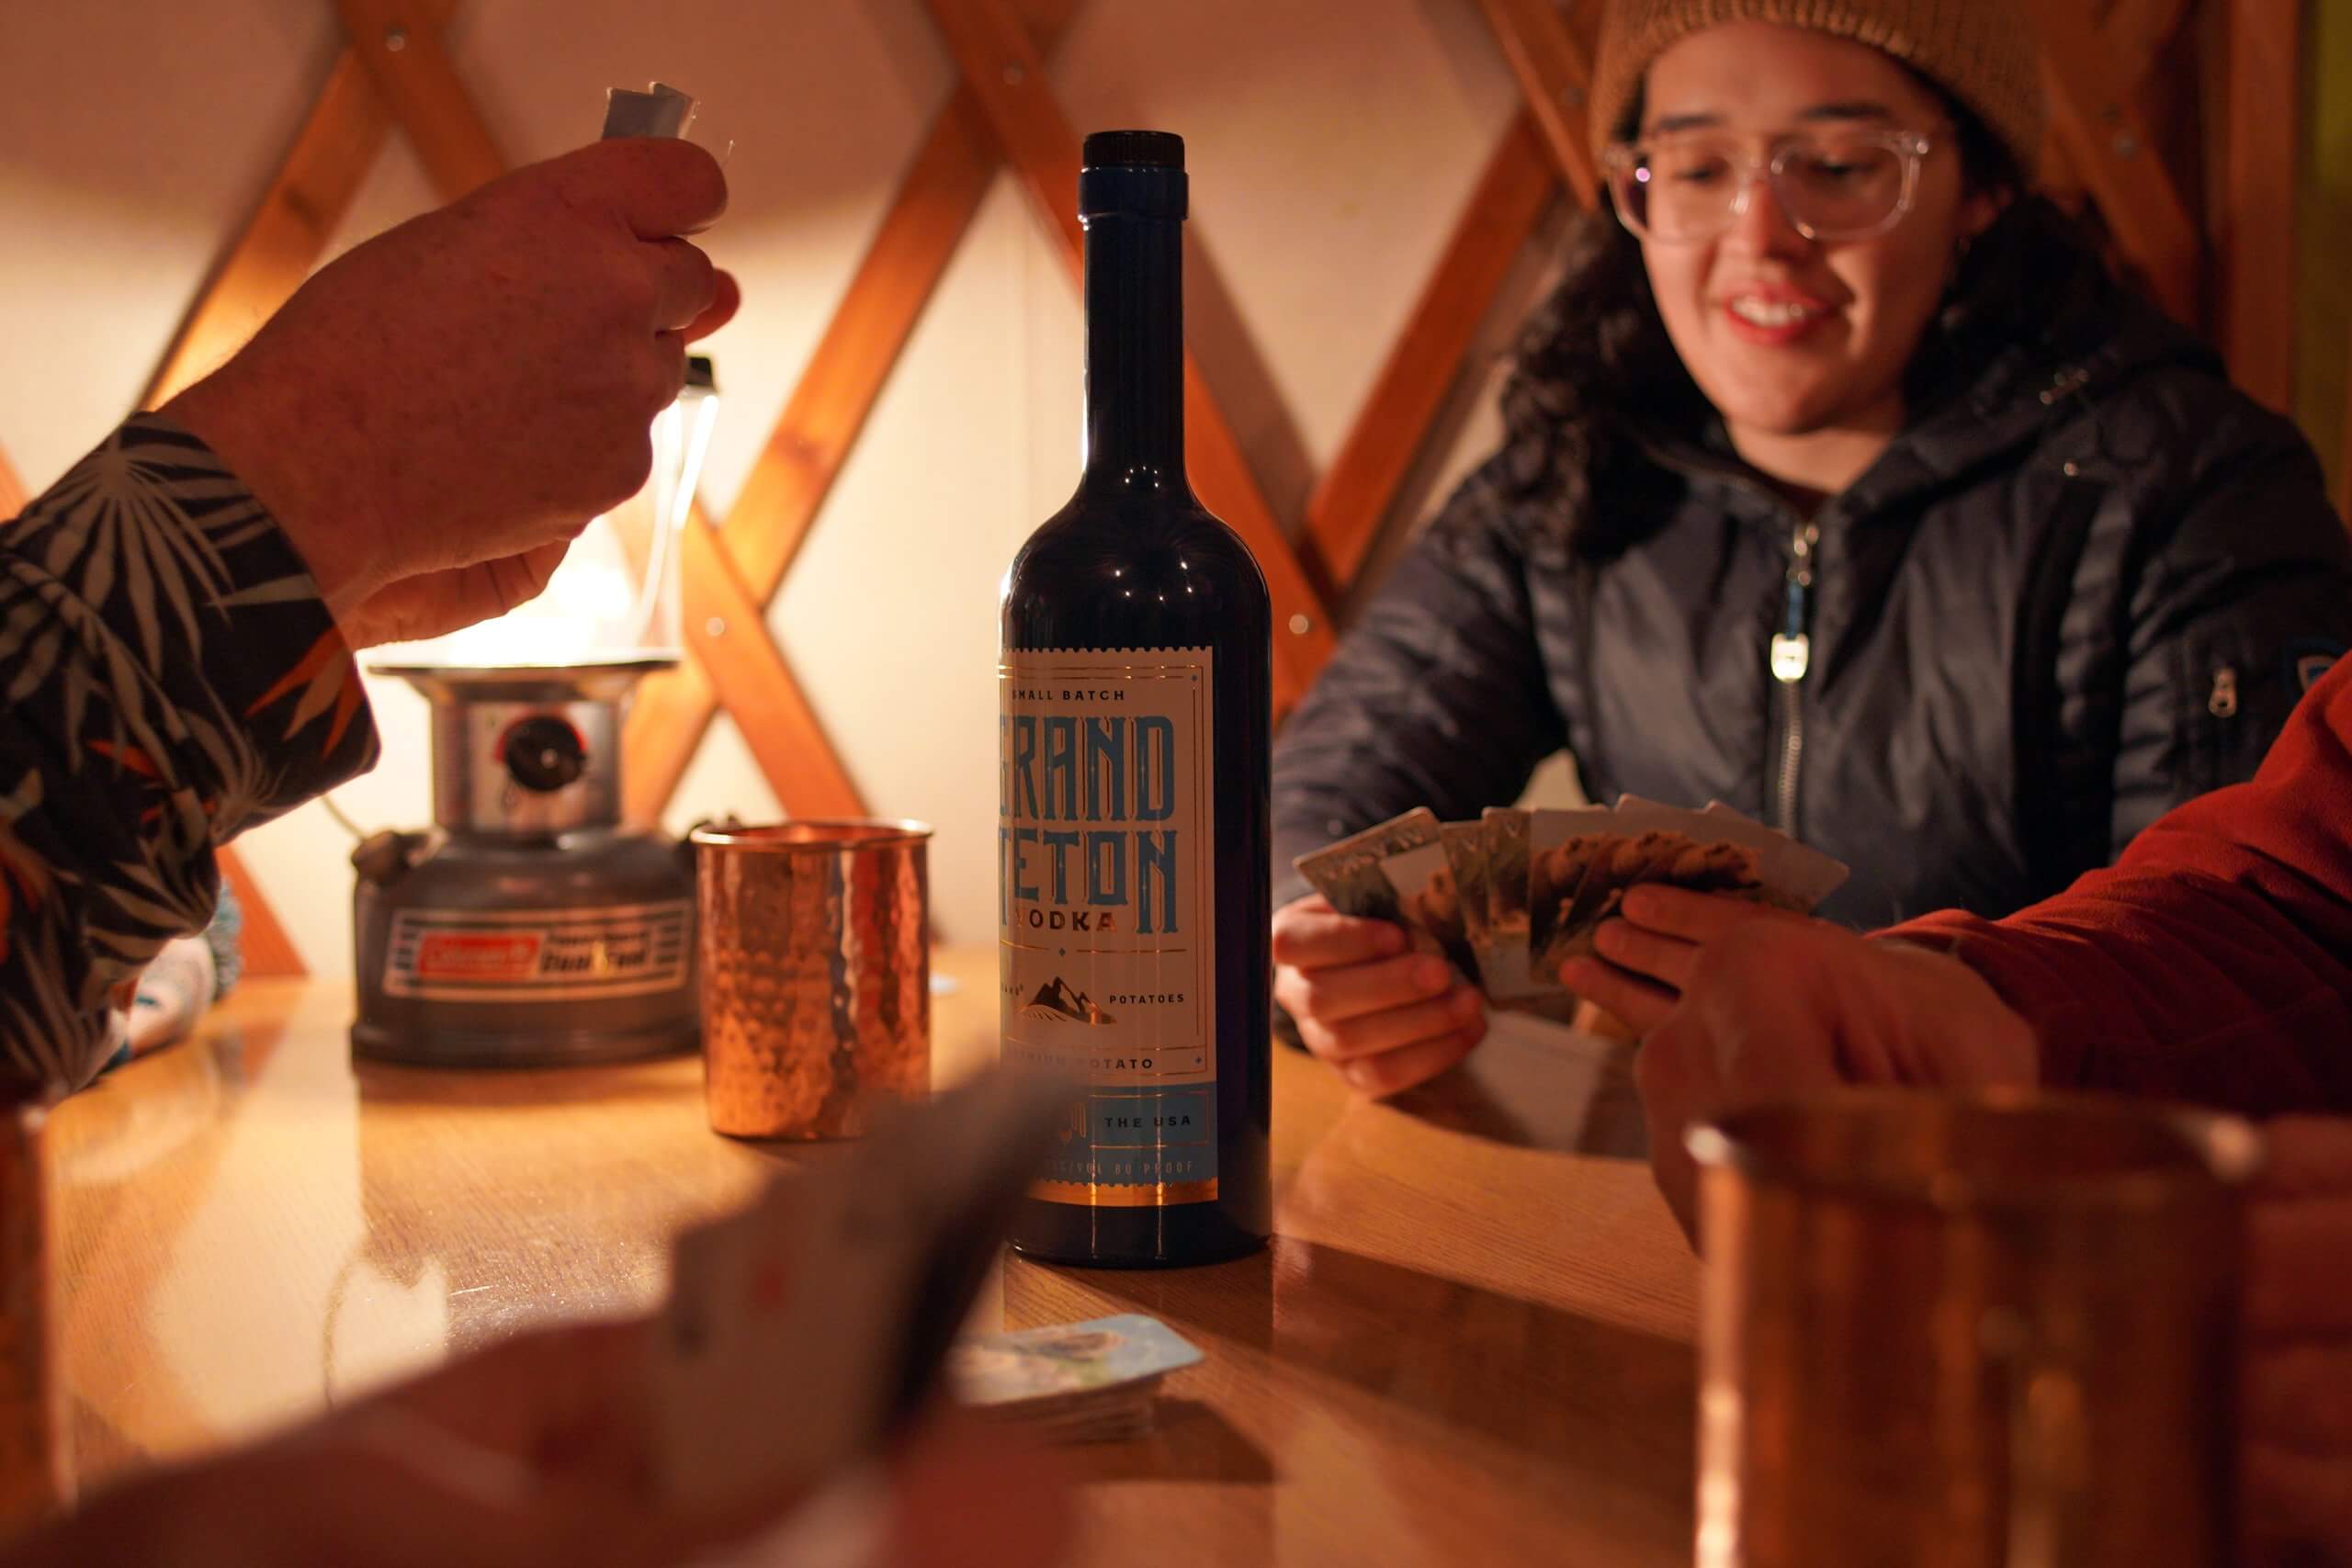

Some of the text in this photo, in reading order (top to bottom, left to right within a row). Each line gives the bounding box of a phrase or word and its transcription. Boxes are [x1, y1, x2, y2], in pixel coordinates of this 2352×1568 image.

[1012, 689, 1125, 701] SMALL BATCH
[999, 826, 1178, 933] TETON
[1014, 908, 1117, 931] VODKA
[1109, 992, 1185, 1005] POTATOES
[1079, 1057, 1153, 1070] OTATO
[1104, 1115, 1192, 1128] THE USA
[1143, 1160, 1193, 1176] PROOF
